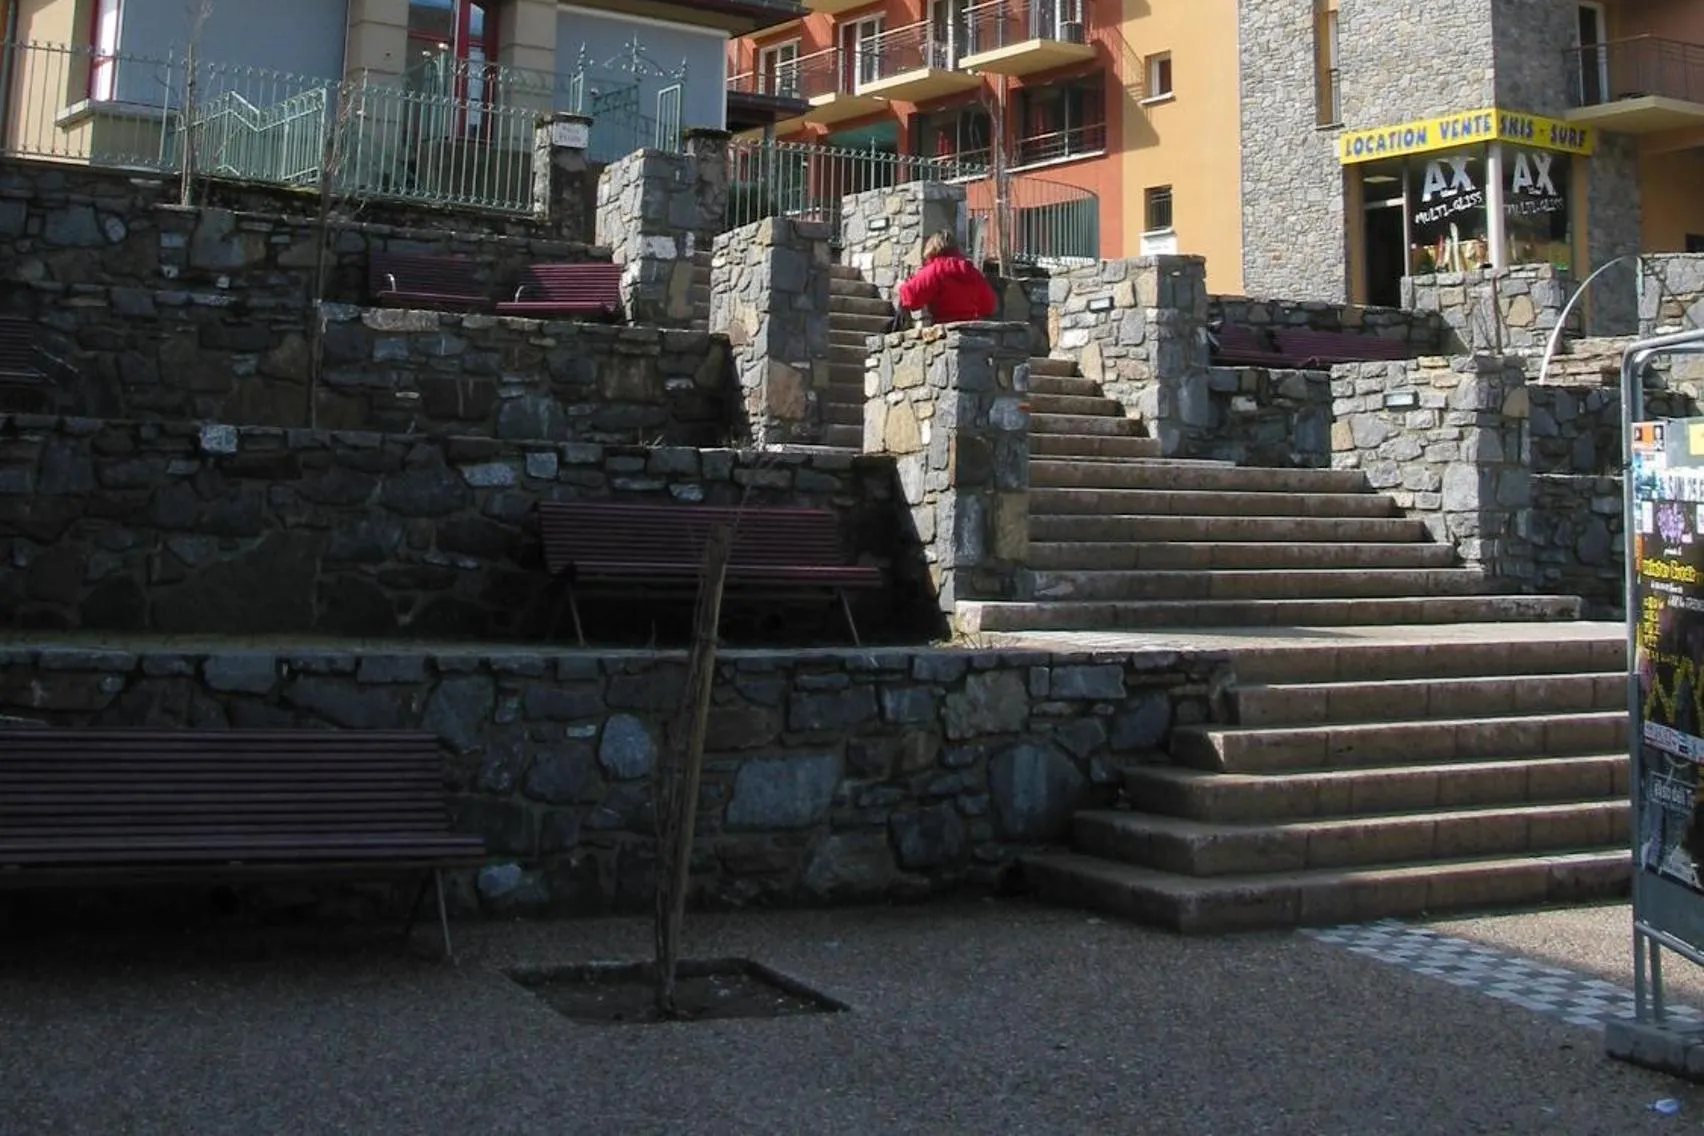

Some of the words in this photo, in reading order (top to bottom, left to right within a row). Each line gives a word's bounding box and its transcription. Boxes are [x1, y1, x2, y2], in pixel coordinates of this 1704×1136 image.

[1344, 125, 1428, 157] LOCATION
[1439, 113, 1493, 140] VENTE
[1422, 158, 1475, 202] AX
[1512, 152, 1557, 196] AX
